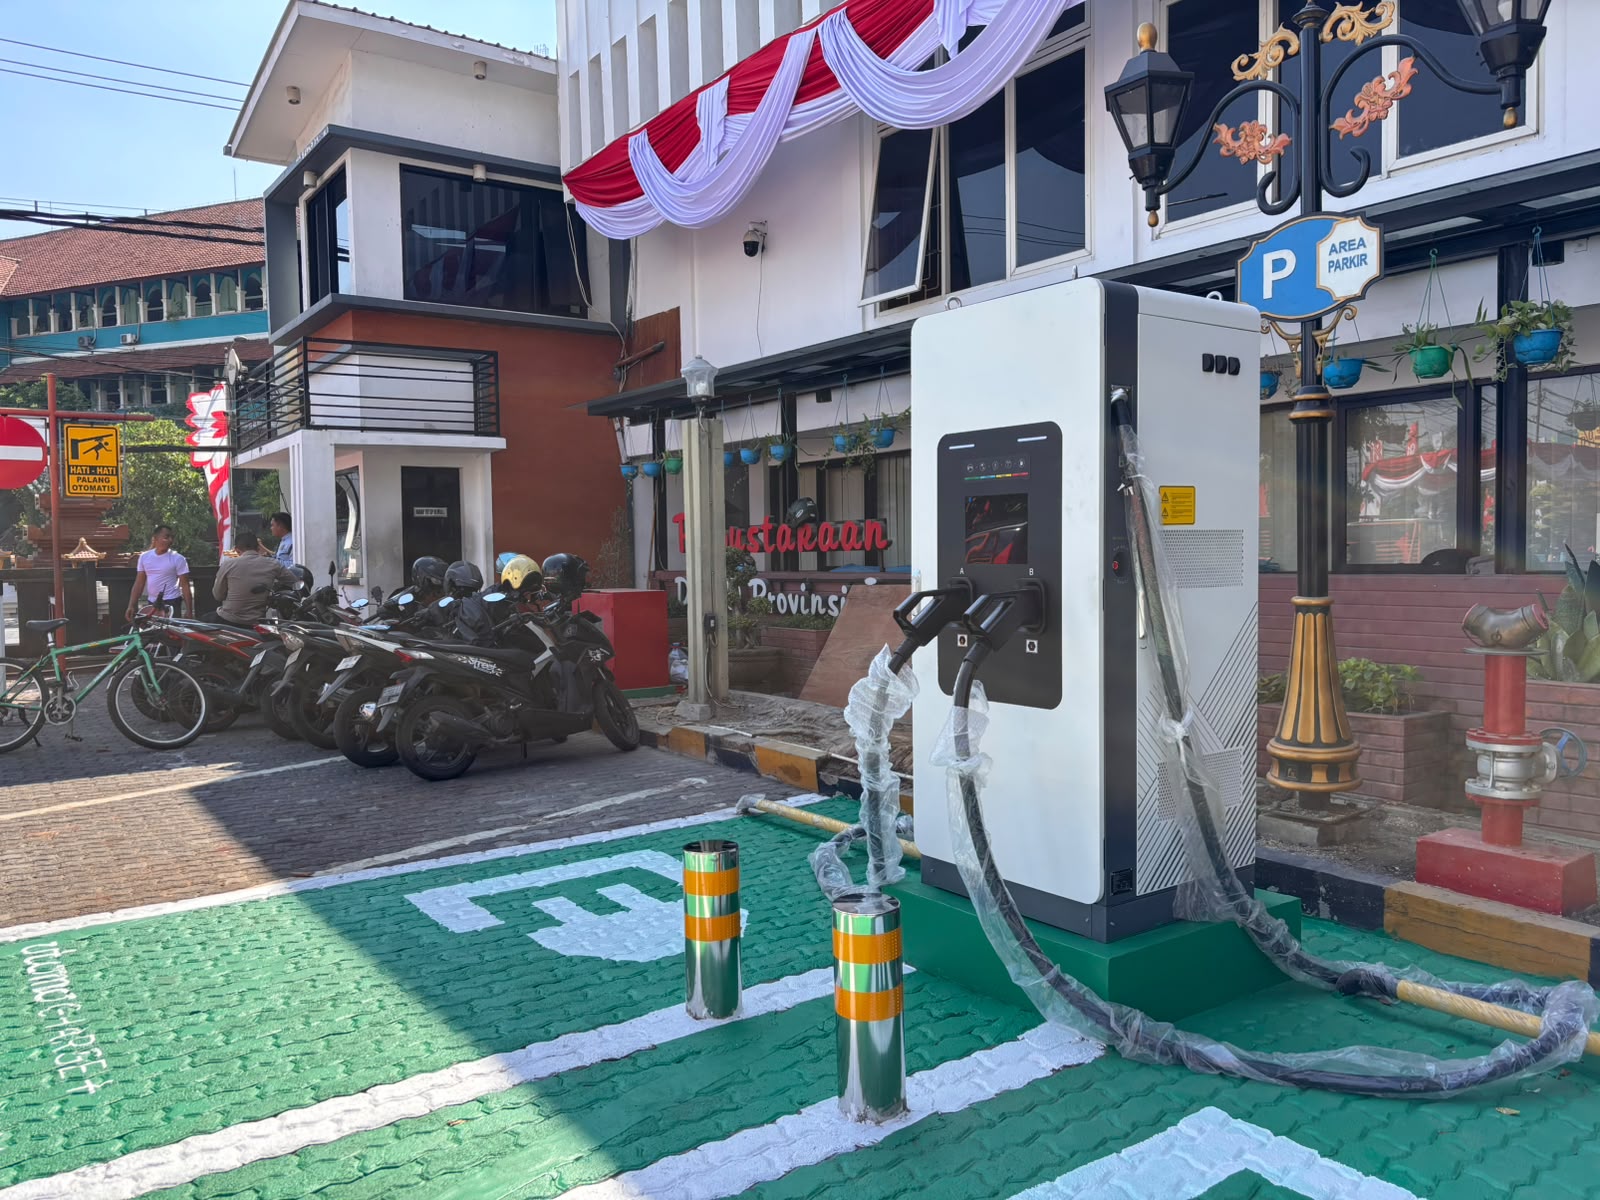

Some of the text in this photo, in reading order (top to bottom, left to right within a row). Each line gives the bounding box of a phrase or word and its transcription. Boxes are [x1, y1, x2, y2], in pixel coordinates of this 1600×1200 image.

[1328, 237, 1367, 257] AREA
[1327, 253, 1369, 273] PARKIR
[1262, 248, 1297, 301] P
[70, 466, 90, 475] HATI
[96, 466, 116, 475] HATI
[76, 476, 111, 484] PALANG
[71, 484, 116, 492] OTOMATIS
[959, 567, 965, 575] A
[1029, 567, 1034, 576] B
[468, 656, 497, 671] Street
